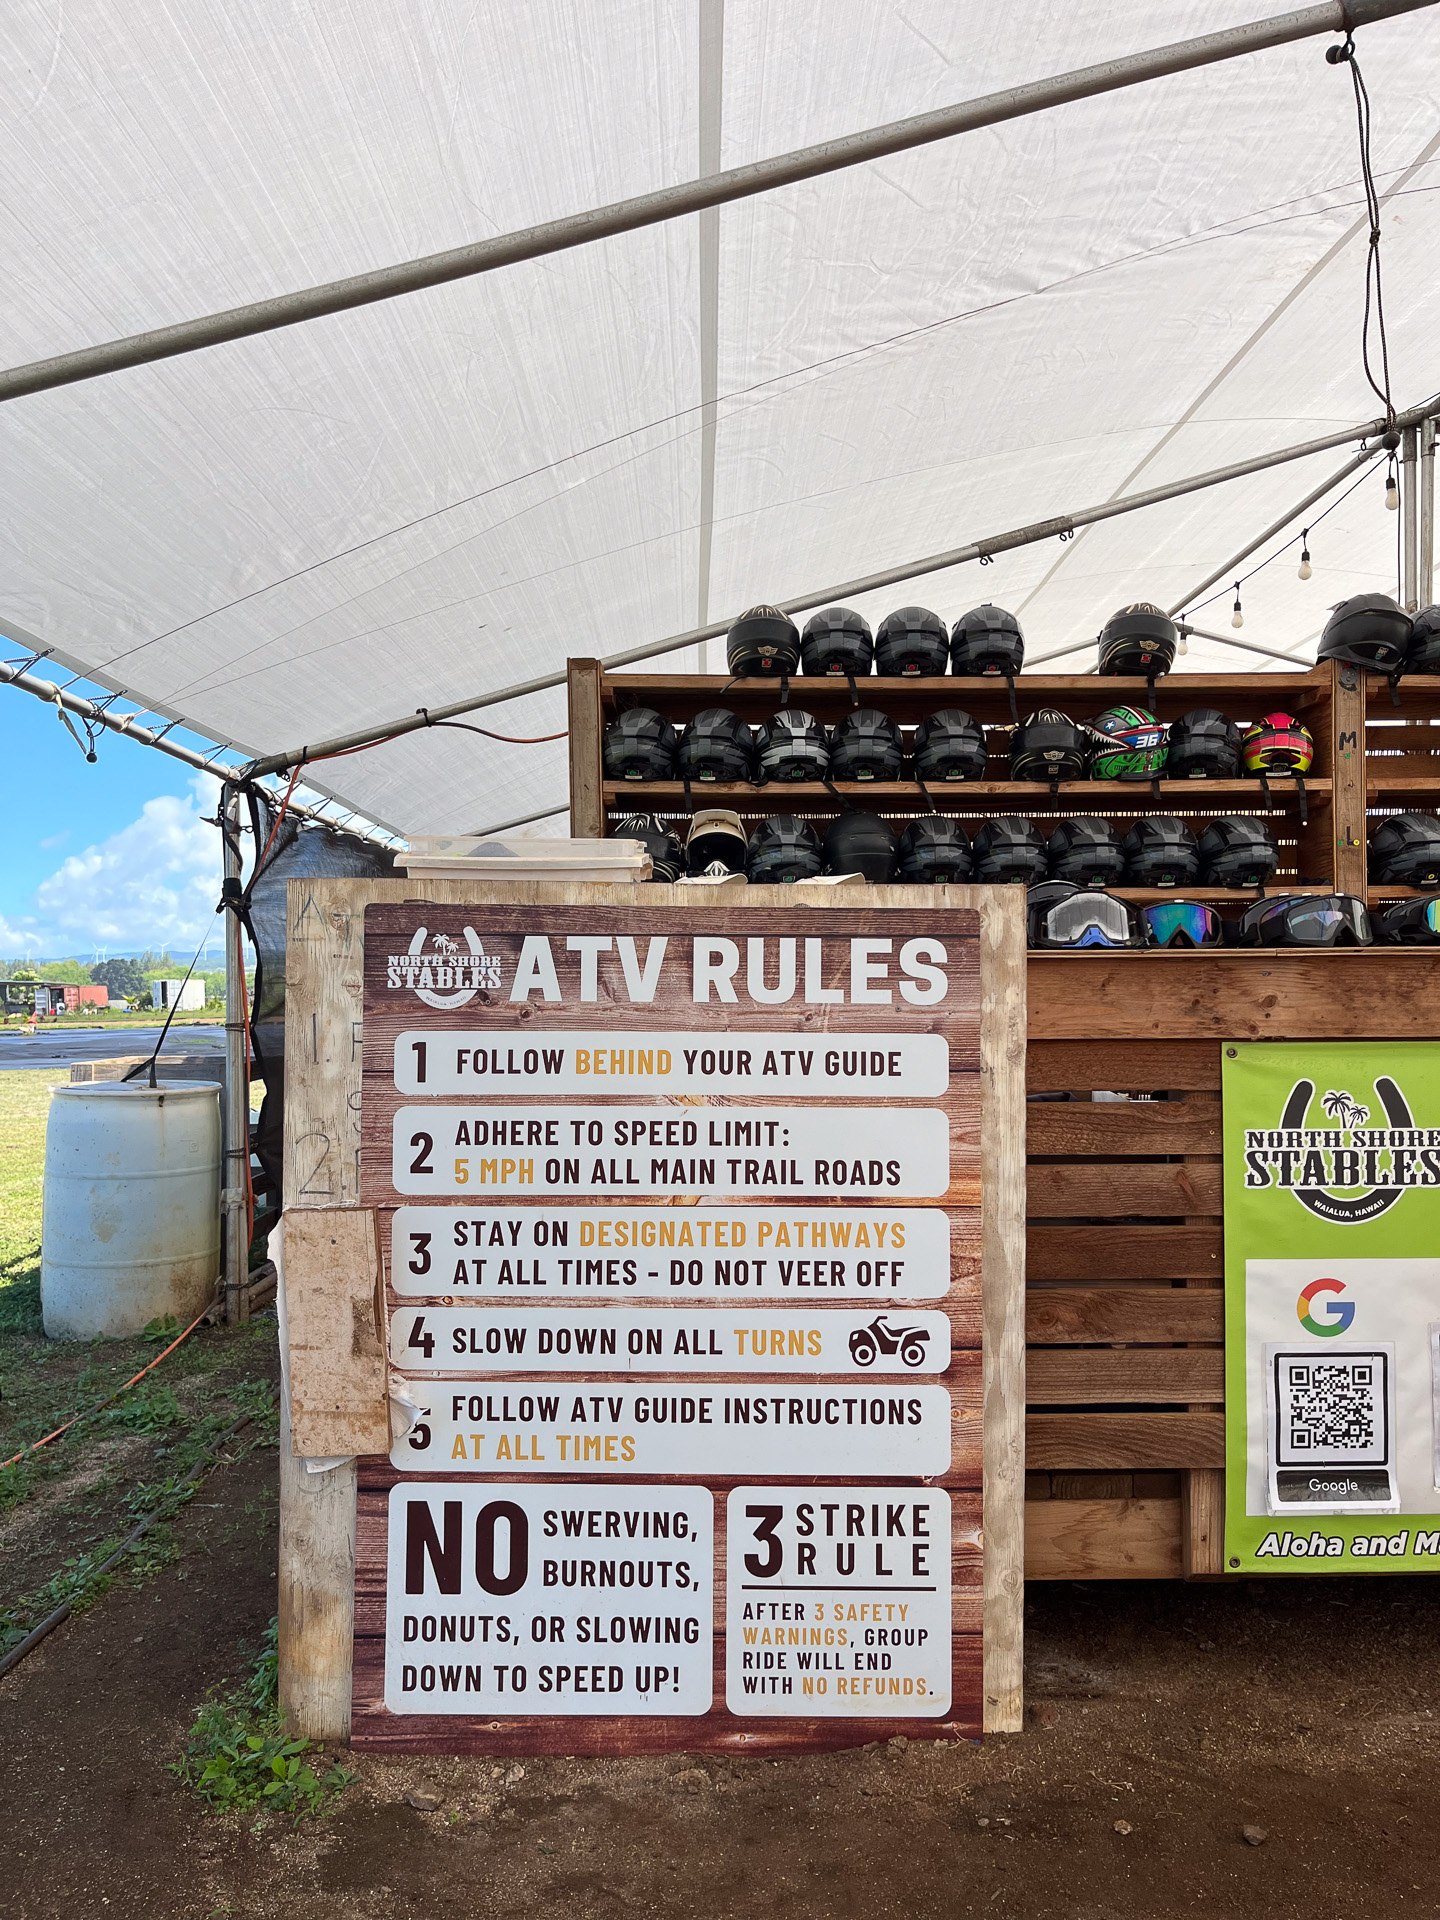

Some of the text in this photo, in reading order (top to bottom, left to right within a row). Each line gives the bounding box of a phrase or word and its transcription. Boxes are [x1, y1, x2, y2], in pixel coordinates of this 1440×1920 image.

[1135, 734, 1158, 749] 36
[1338, 731, 1357, 750] M
[387, 955, 501, 967] NORTH SHORE
[509, 935, 949, 1006] ATV RULES
[386, 966, 502, 989] STABLES
[411, 1041, 902, 1083] 1 FOLLOW BEHIND YOUR ATV GUIDE
[454, 1120, 790, 1147] ADHERE TO SPEED LIMIT:
[1246, 1130, 1440, 1149] NORTH SHORE
[409, 1131, 434, 1175] 2
[454, 1158, 901, 1187] 5 MPH ON ALL MAIN TRAIL ROADS
[1246, 1149, 1440, 1187] STABLES
[1313, 1198, 1385, 1219] WAIALUA, HAWAII
[453, 1220, 906, 1249] STAY ON DESIGNATED PATHWAYS
[408, 1232, 432, 1276] 3
[452, 1259, 488, 1285] AT
[497, 1259, 547, 1285] ALL
[557, 1259, 637, 1286] TIMES
[669, 1259, 704, 1286] DO
[714, 1259, 768, 1287] NOT
[777, 1260, 846, 1287] VEER
[856, 1260, 905, 1287] OFF
[407, 1316, 822, 1359] 4 SLOW DOWN ON ALL TURNS
[452, 1395, 922, 1426] FOLLOW ATV GUIDE INSTRUCTIONS
[450, 1433, 636, 1462] AT ALL TIMES
[1308, 1478, 1359, 1495] Google
[796, 1503, 931, 1538] STRIKE
[405, 1500, 699, 1596] NO SWERVING,
[743, 1504, 784, 1579] 3
[1256, 1530, 1440, 1557] Aloha and M
[797, 1542, 931, 1577] RULE
[542, 1559, 700, 1592] BURNOUTS,
[742, 1602, 909, 1622] AFTER 3 SAFETY
[402, 1615, 700, 1646] DONUTS, OR SLOWING
[742, 1626, 929, 1650] WARNINGS, GROUP
[742, 1651, 892, 1671] RIDE WILL END
[401, 1664, 680, 1693] DOWN TO SPEED UP!
[742, 1675, 934, 1696] WITH NO REFUNDS.
